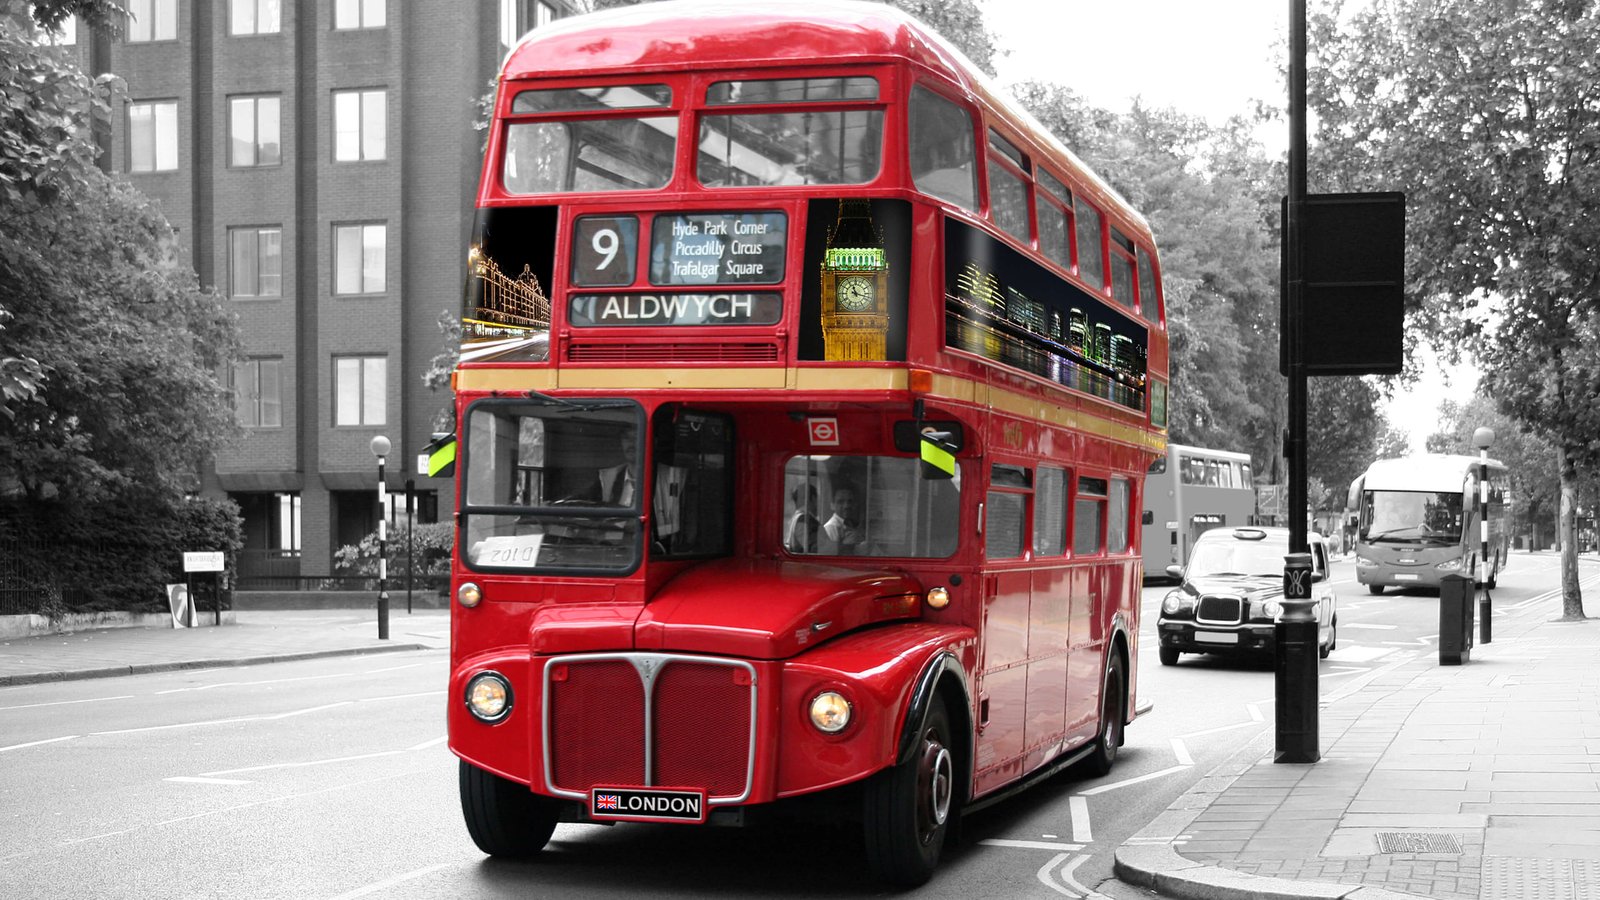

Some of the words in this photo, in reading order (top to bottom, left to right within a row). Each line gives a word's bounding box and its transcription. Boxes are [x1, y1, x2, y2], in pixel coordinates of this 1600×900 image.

[672, 221, 698, 240] Hyde
[704, 221, 728, 235] Park
[734, 220, 768, 235] Corner
[592, 228, 619, 270] 9
[675, 240, 725, 259] Piccadilly
[731, 240, 763, 255] Circus
[672, 261, 719, 278] Trafalgar
[726, 260, 763, 278] Square
[601, 295, 751, 319] ALDWYCH
[617, 795, 699, 813] LONDON
